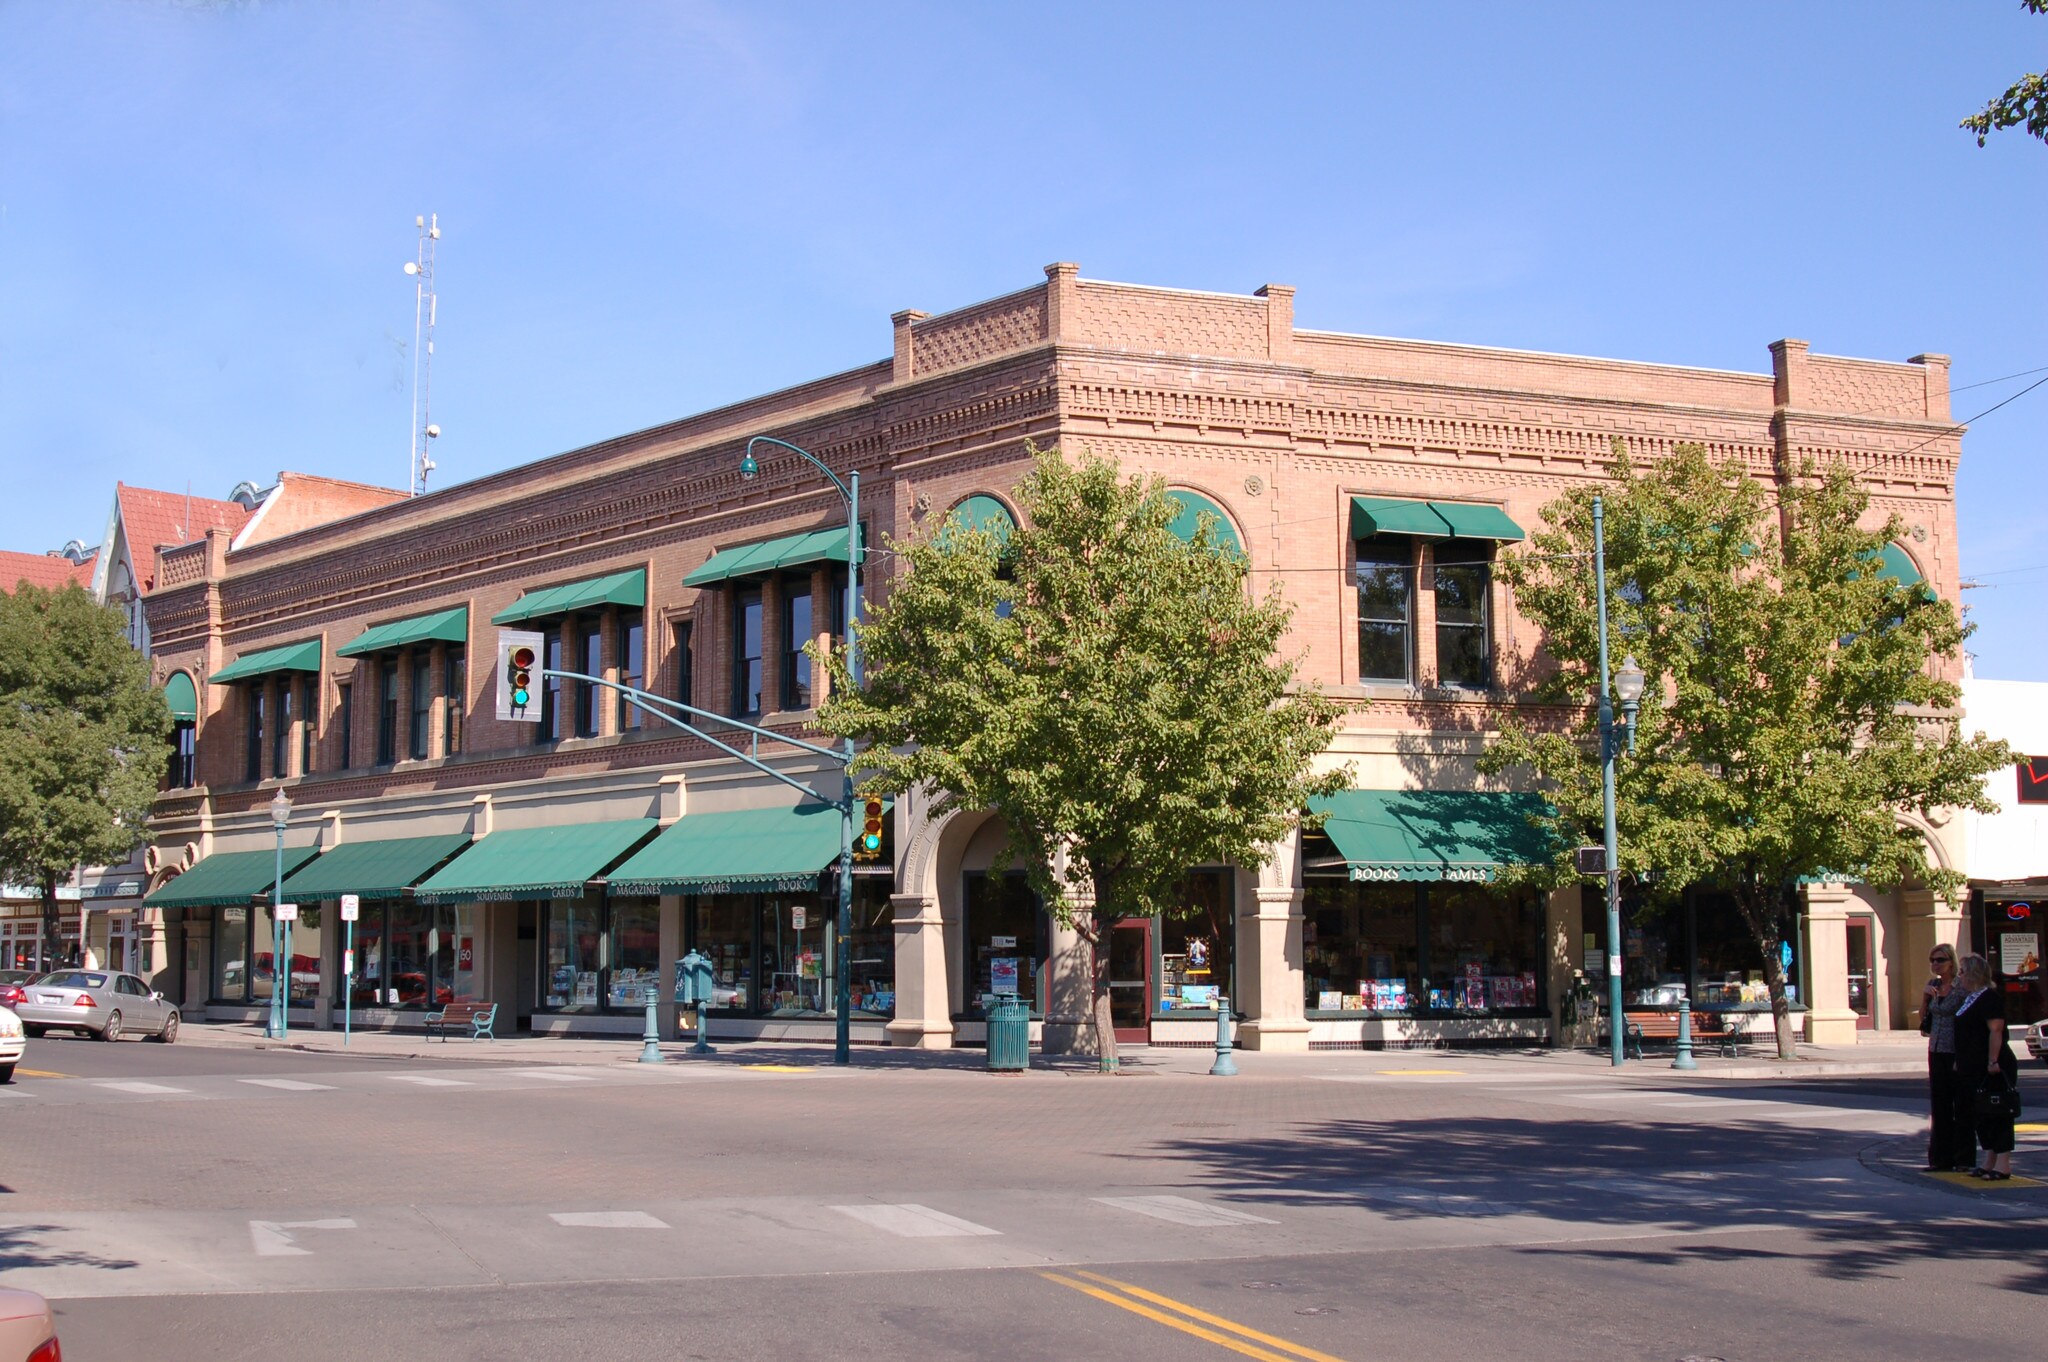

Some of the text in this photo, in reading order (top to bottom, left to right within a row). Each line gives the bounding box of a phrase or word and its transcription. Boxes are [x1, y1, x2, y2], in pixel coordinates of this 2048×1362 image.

[1354, 868, 1487, 881] BOOKS GAMES
[616, 880, 807, 896] MAGAZINES GAMES BOOKS
[422, 889, 575, 904] GIFTS SOUVENIRS CARDS
[2008, 906, 2030, 917] OPEN
